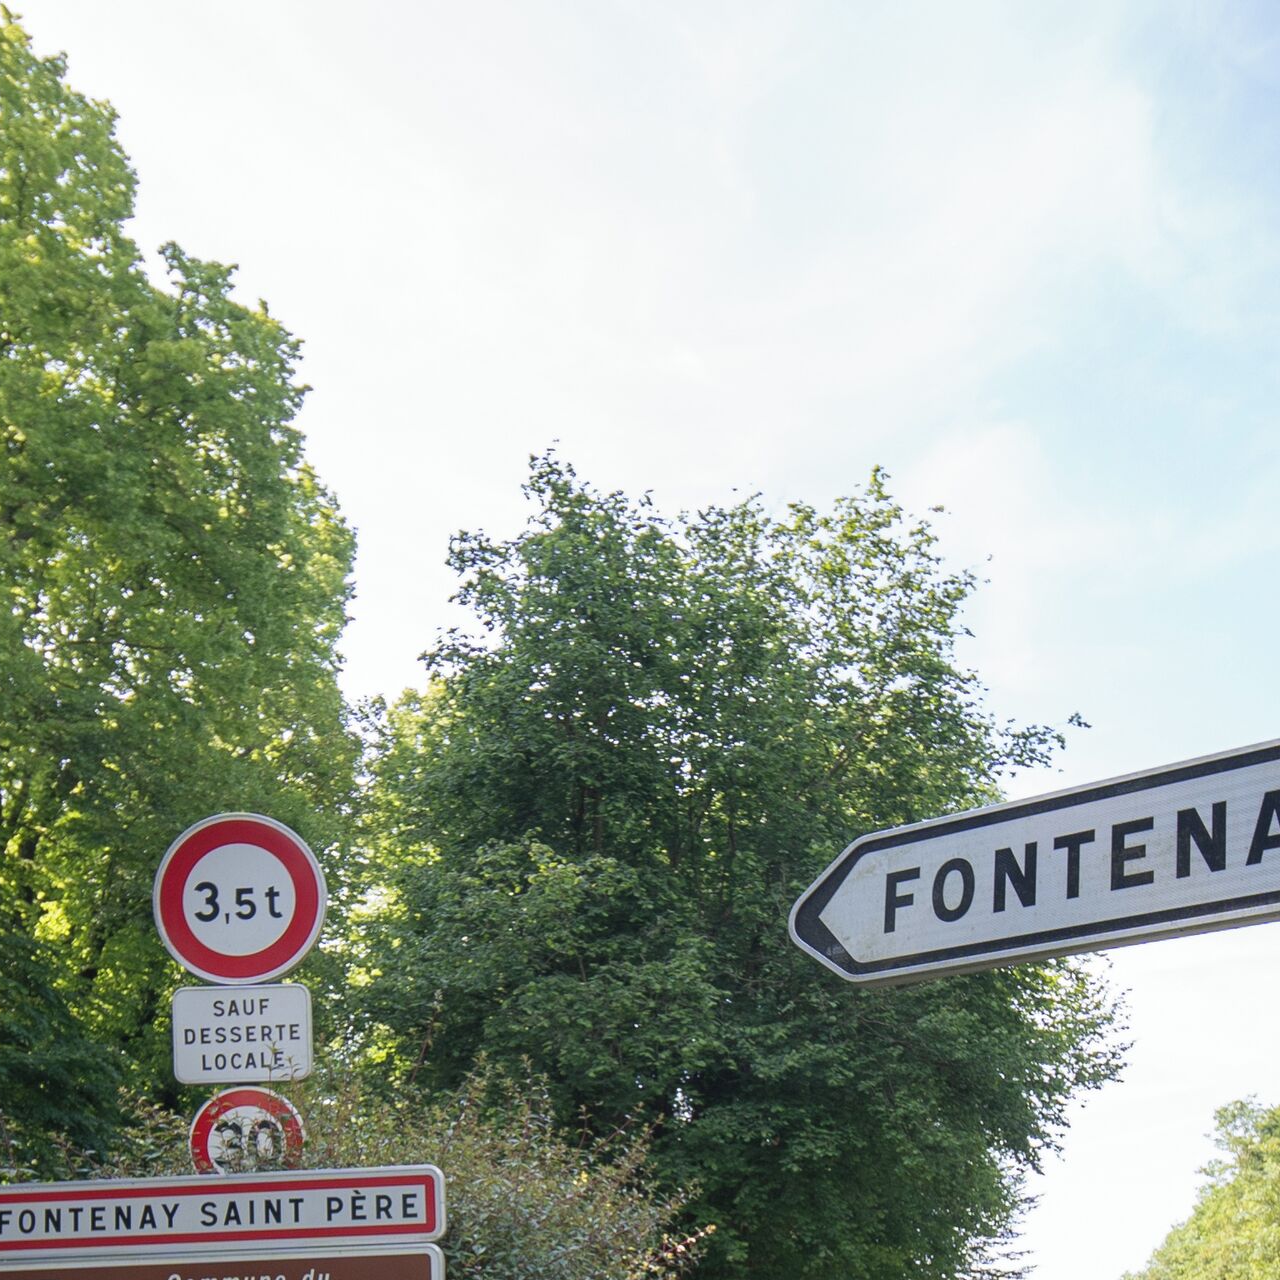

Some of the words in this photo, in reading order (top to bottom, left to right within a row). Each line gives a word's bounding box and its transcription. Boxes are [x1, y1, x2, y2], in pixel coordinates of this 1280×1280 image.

[213, 998, 270, 1017] SAUF
[183, 1023, 301, 1045] DESSERTE
[201, 1051, 285, 1071] LOCALE
[200, 1197, 305, 1227] SAINT
[326, 1190, 420, 1222] PÈRE
